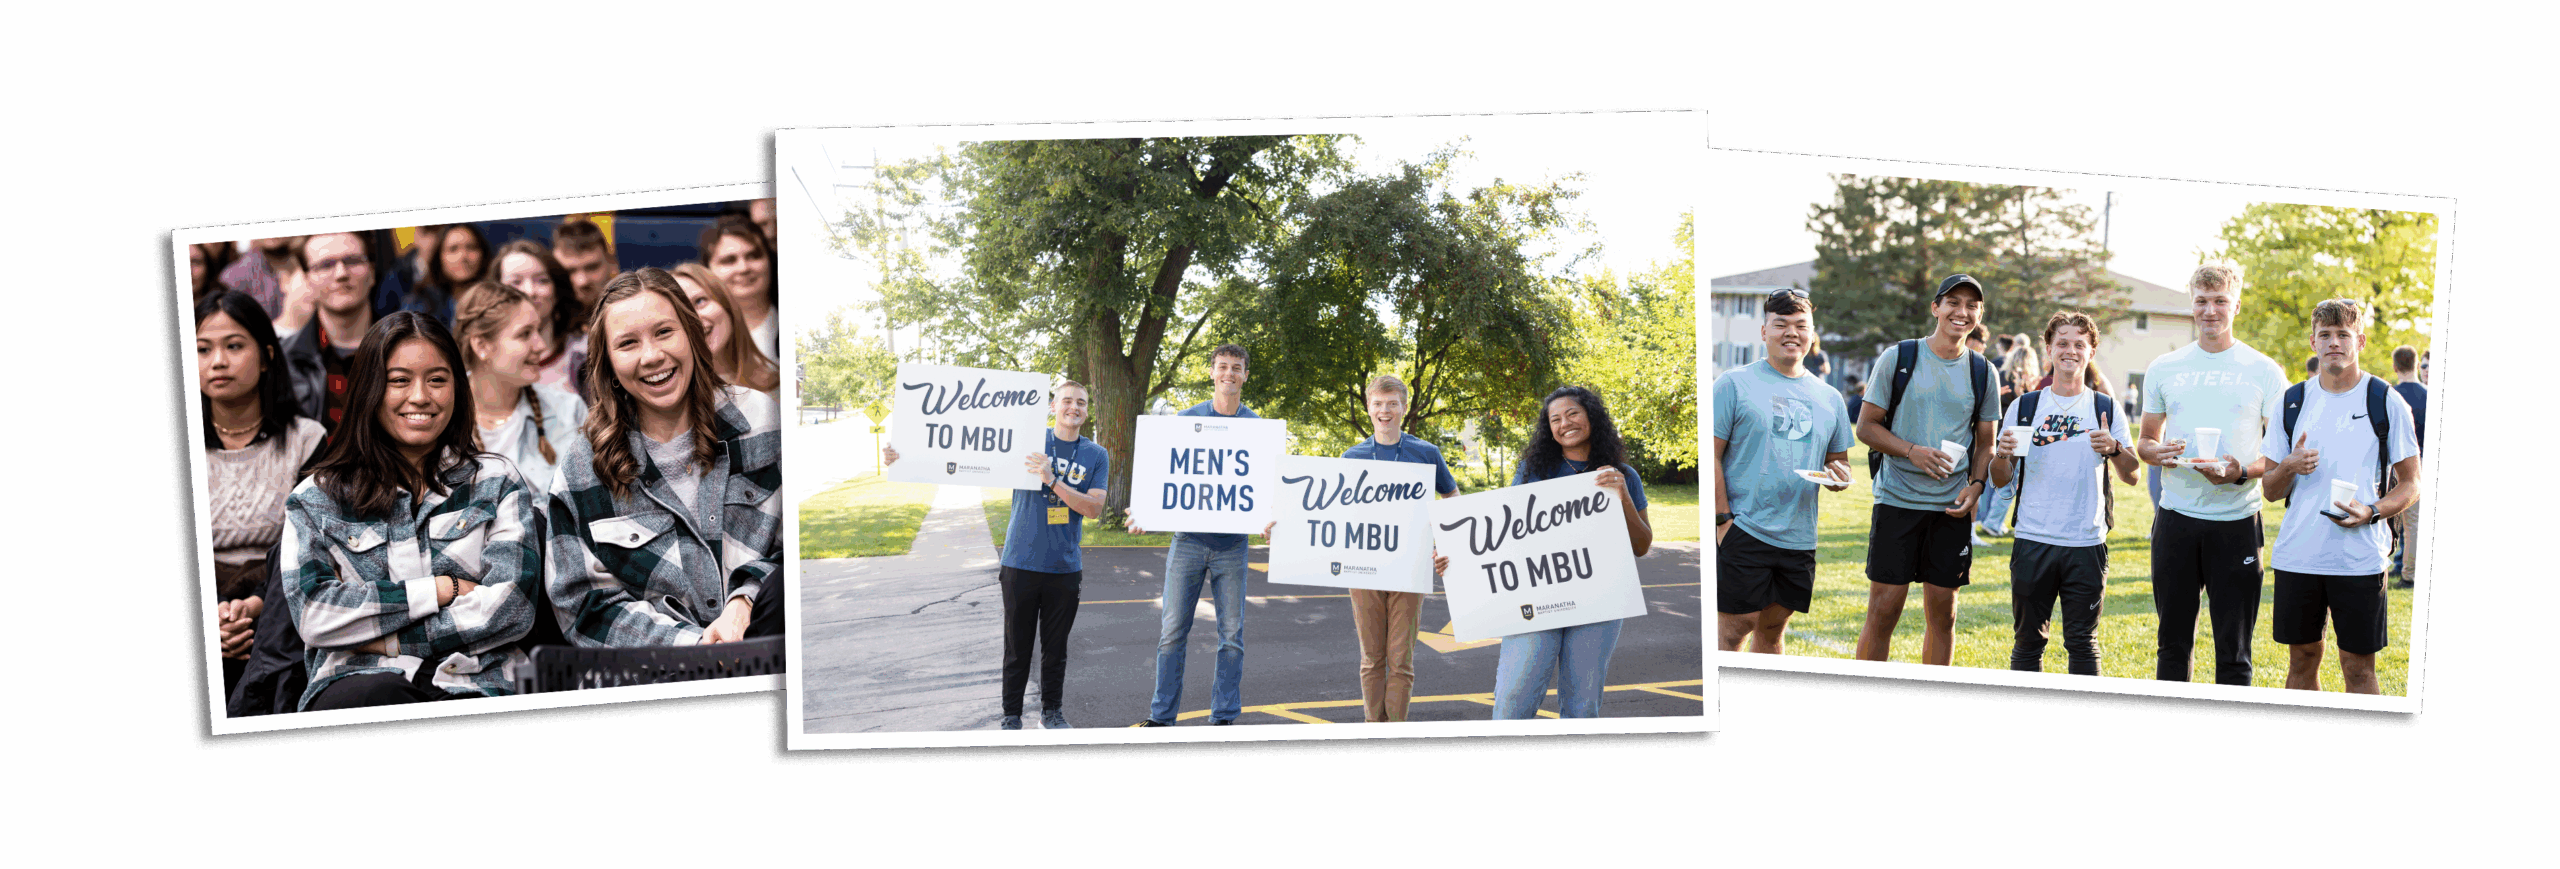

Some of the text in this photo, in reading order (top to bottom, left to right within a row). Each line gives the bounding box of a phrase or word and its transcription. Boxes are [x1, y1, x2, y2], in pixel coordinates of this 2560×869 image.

[2173, 370, 2250, 386] STEEL
[902, 377, 1041, 416] Welcome
[926, 423, 1013, 453] TO MBU
[1047, 456, 1087, 485] BU
[1170, 447, 1250, 477] MEN'S
[1162, 482, 1254, 512] DORMS
[1281, 469, 1427, 511] Welcome
[1307, 519, 1399, 552] TO MBU
[1439, 491, 1610, 556] Welcome
[1481, 547, 1593, 594] TO MBU
[1536, 600, 1576, 611] MARANATHA
